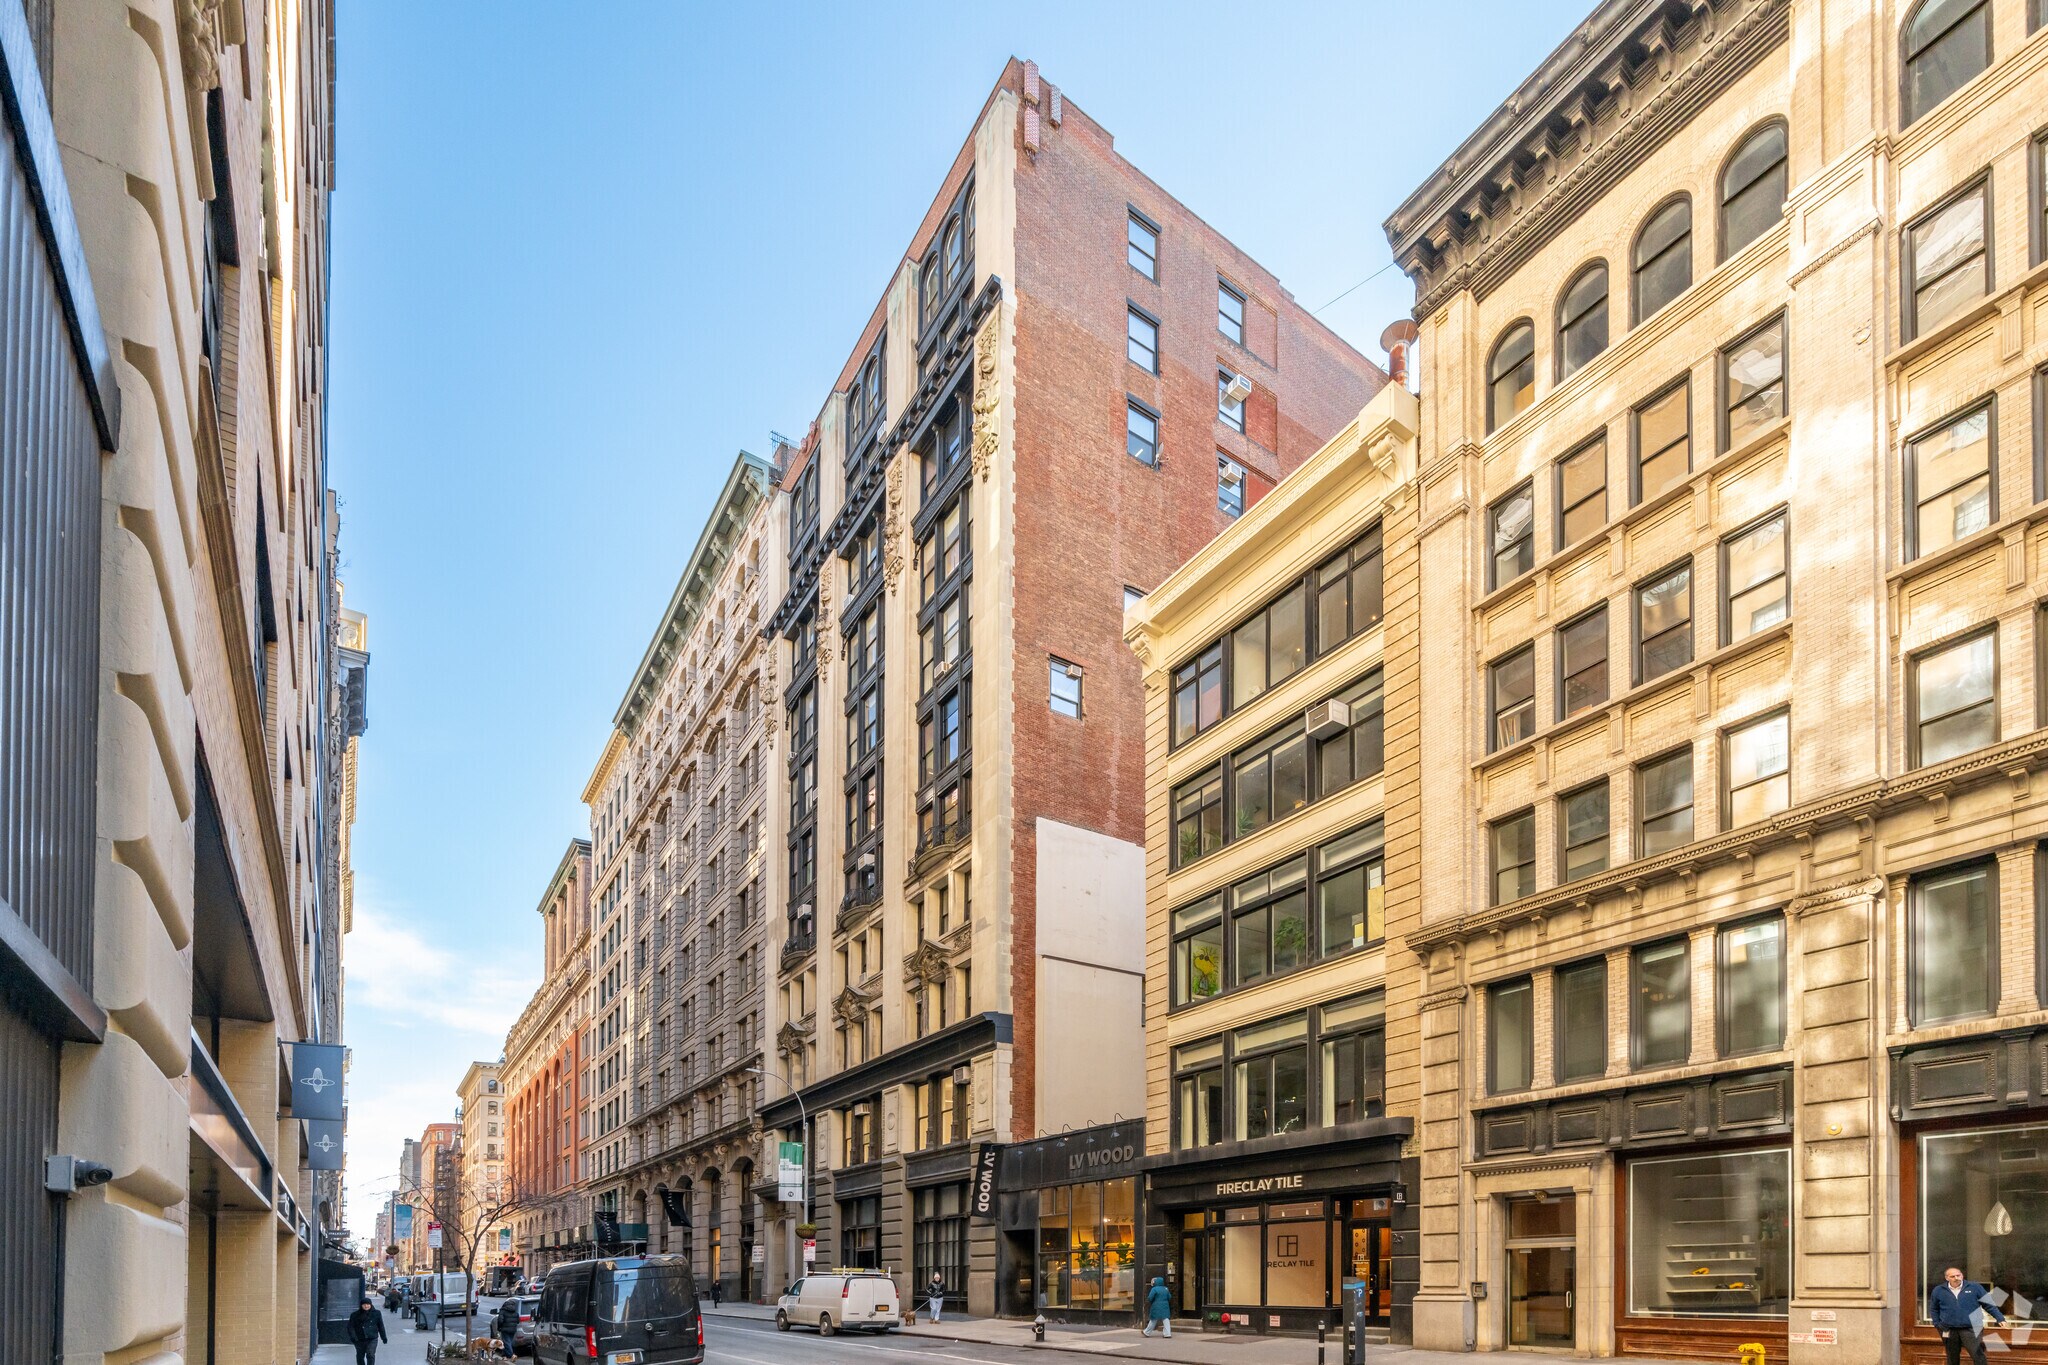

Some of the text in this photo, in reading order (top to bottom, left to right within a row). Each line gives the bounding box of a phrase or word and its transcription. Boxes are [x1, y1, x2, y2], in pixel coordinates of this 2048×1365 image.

[1069, 1145, 1134, 1170] LV WOOD
[978, 1152, 996, 1213] LV WOOD
[1216, 1175, 1303, 1195] FIRECLAY TILE
[1266, 1260, 1297, 1268] RECLAY
